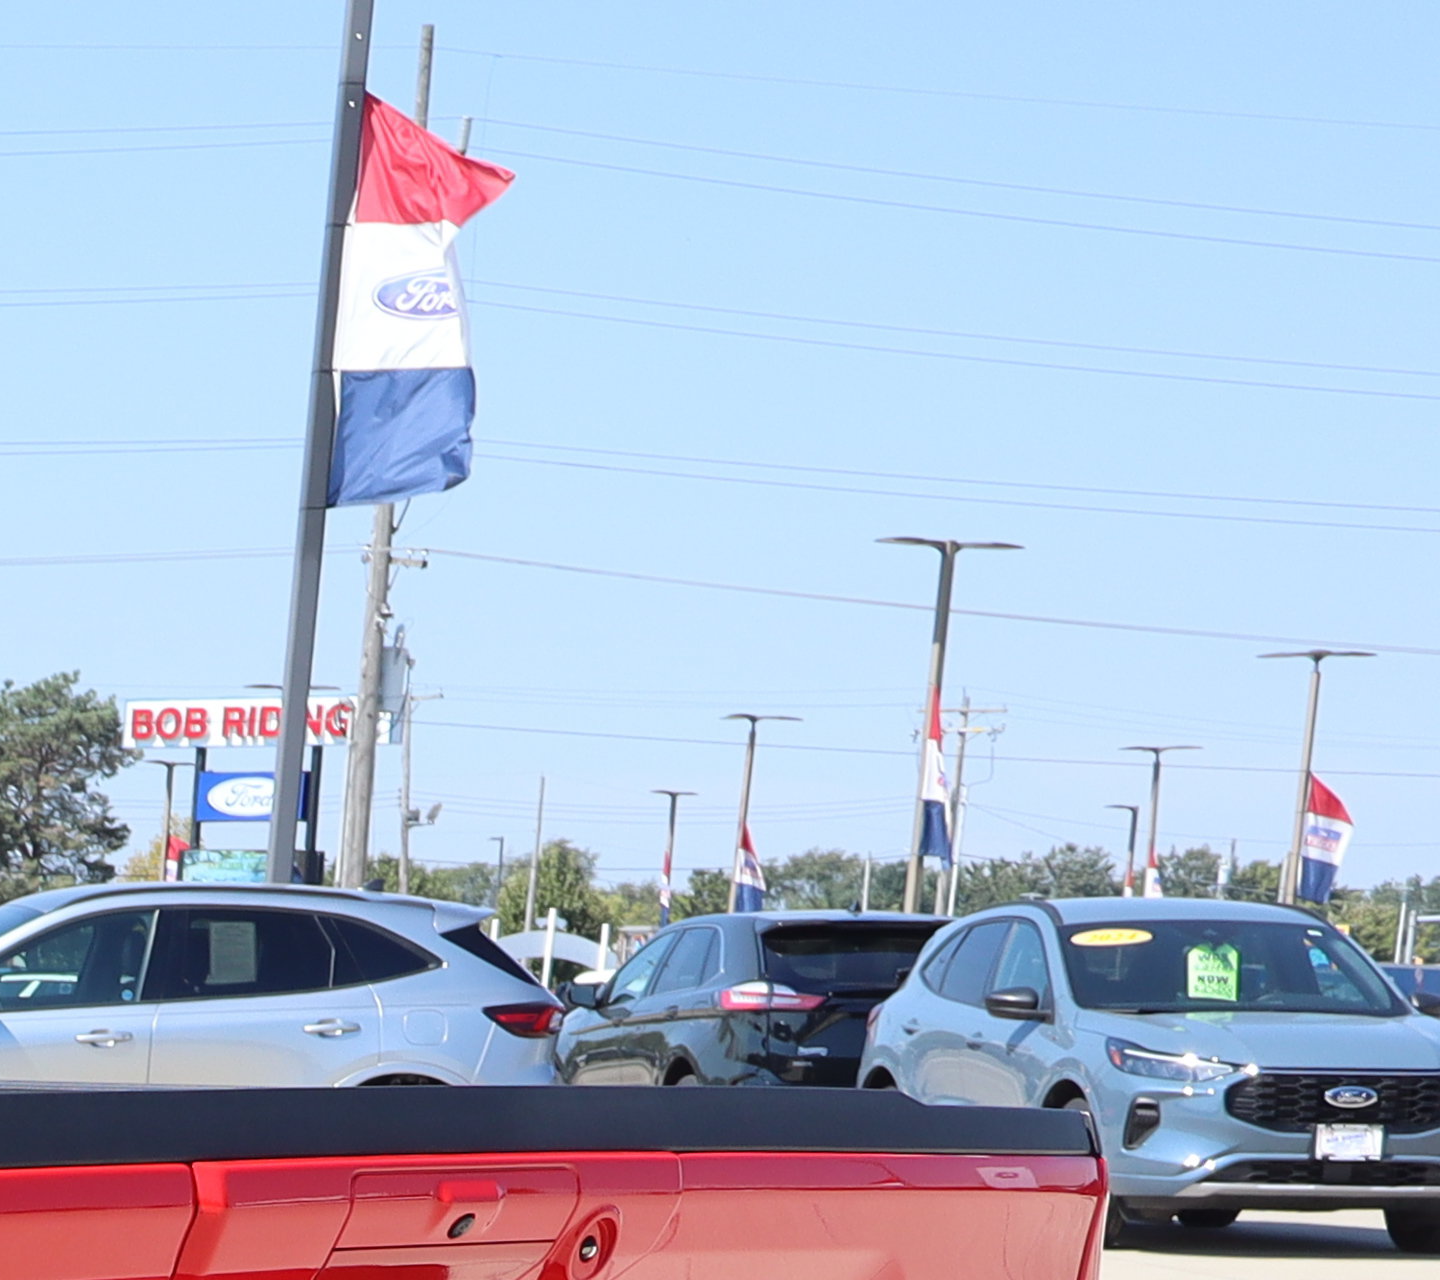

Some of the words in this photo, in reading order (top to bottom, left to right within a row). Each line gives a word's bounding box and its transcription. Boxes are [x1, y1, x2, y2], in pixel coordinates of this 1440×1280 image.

[132, 707, 207, 740] BOB
[222, 704, 353, 739] RIDNG
[1197, 975, 1229, 985] NOW
